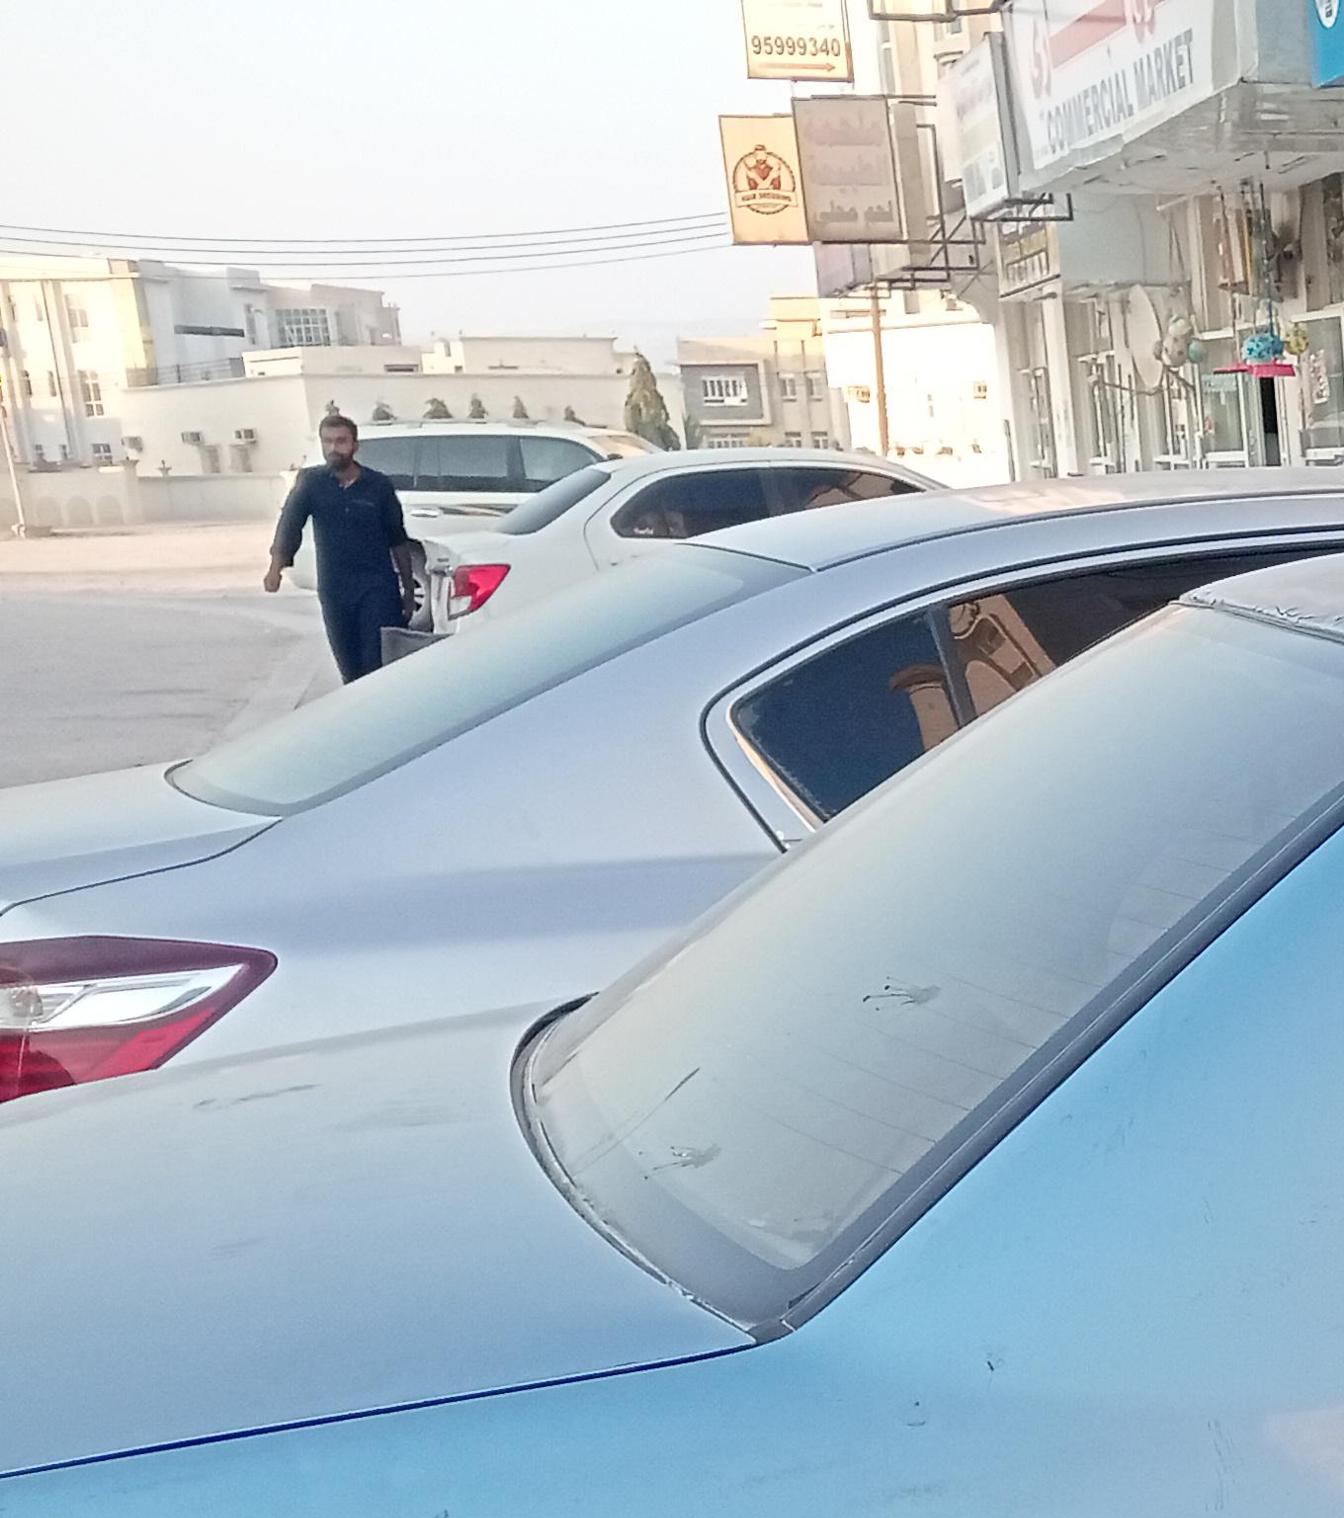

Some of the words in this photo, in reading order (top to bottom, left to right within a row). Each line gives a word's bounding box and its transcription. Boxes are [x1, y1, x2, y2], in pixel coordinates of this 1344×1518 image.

[751, 35, 841, 57] 95999340
[1047, 69, 1134, 154] COMMERCIAL
[1134, 28, 1194, 110] MARKET
